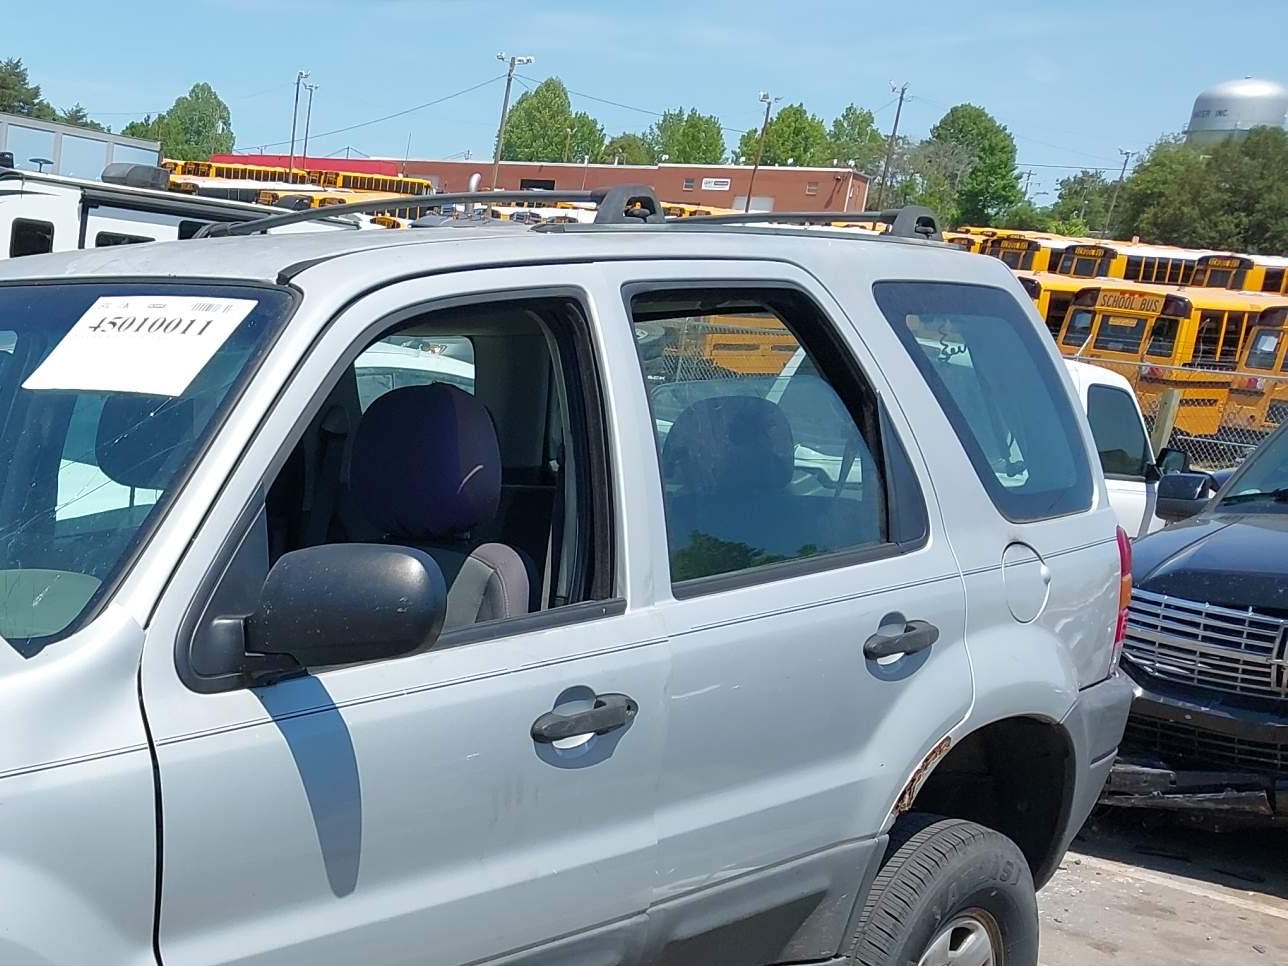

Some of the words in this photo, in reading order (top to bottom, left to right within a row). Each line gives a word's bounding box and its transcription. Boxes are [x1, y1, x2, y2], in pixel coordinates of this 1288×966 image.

[1101, 294, 1137, 311] SCHOOL
[1140, 298, 1160, 312] BUS
[88, 315, 214, 336] 45010011
